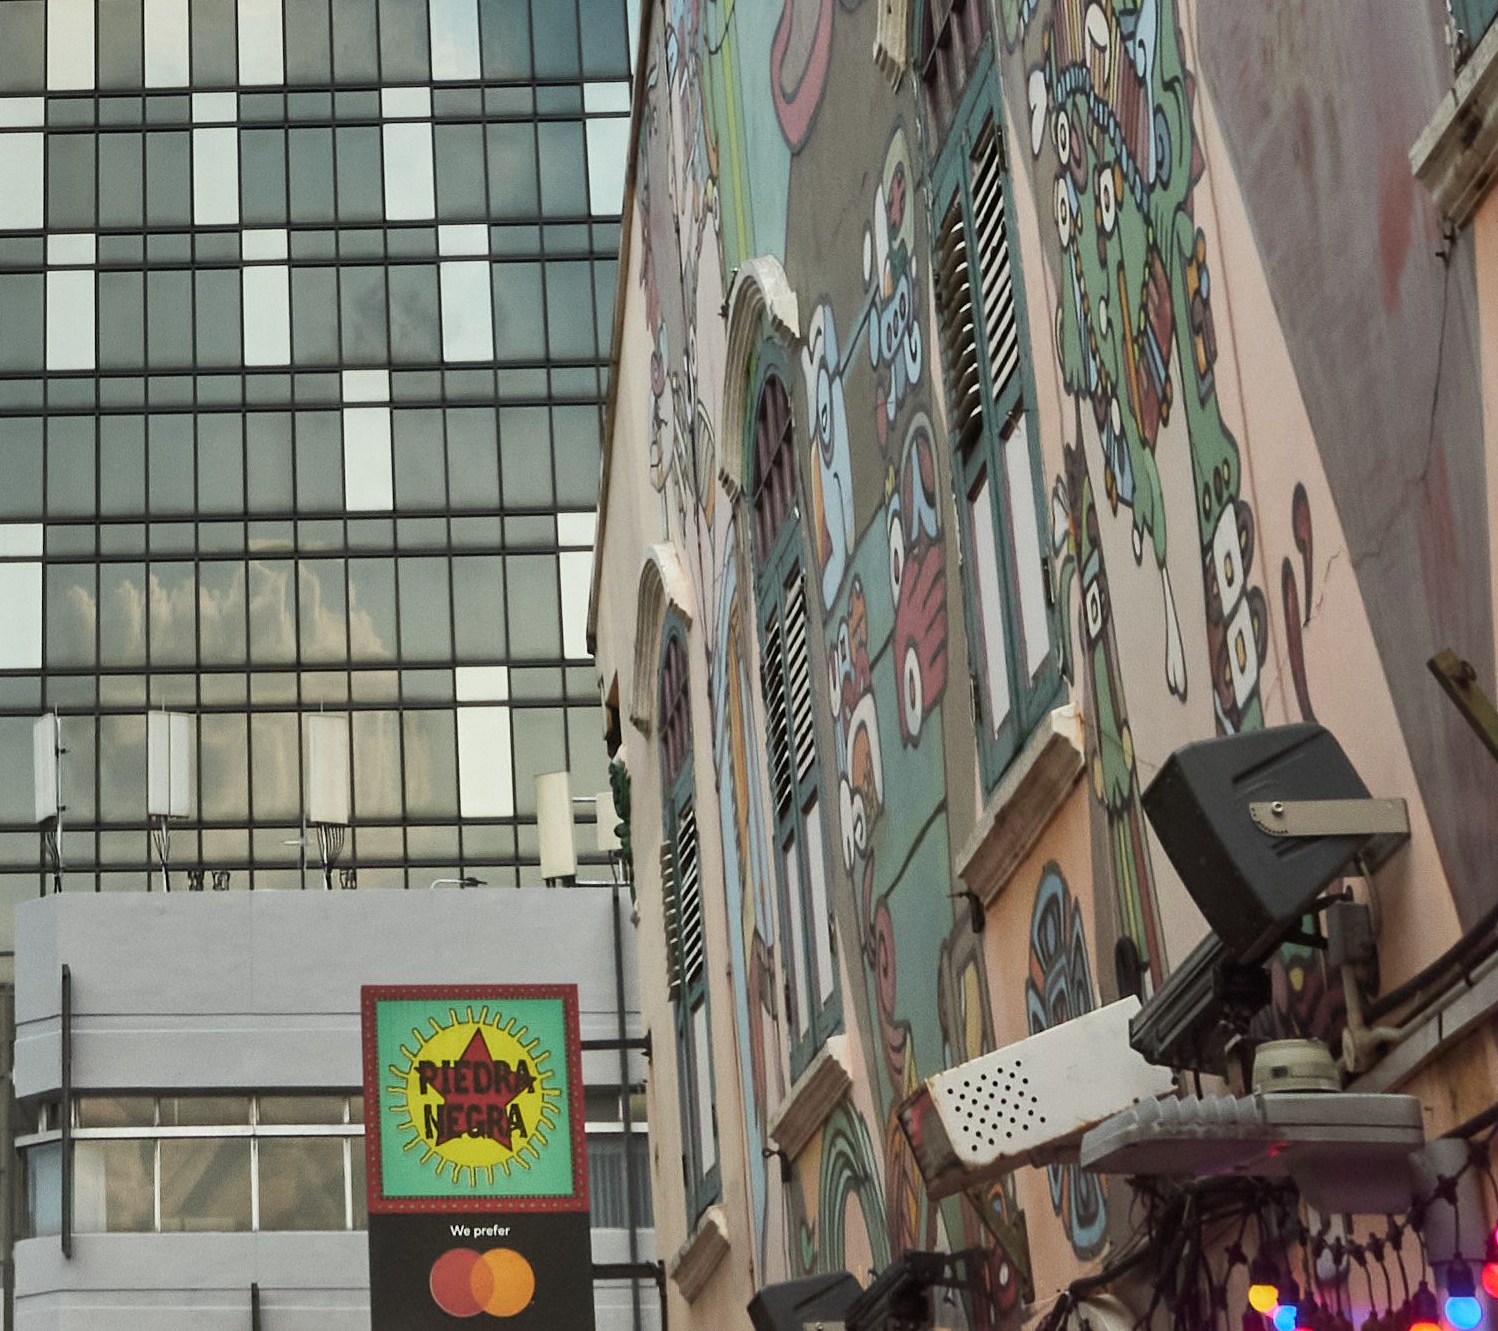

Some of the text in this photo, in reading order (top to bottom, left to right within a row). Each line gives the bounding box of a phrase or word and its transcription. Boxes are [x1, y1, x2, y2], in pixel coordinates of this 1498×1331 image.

[418, 1059, 535, 1095] PIEDRA
[424, 1103, 528, 1139] NEGRA
[450, 1224, 510, 1238] We prefer
